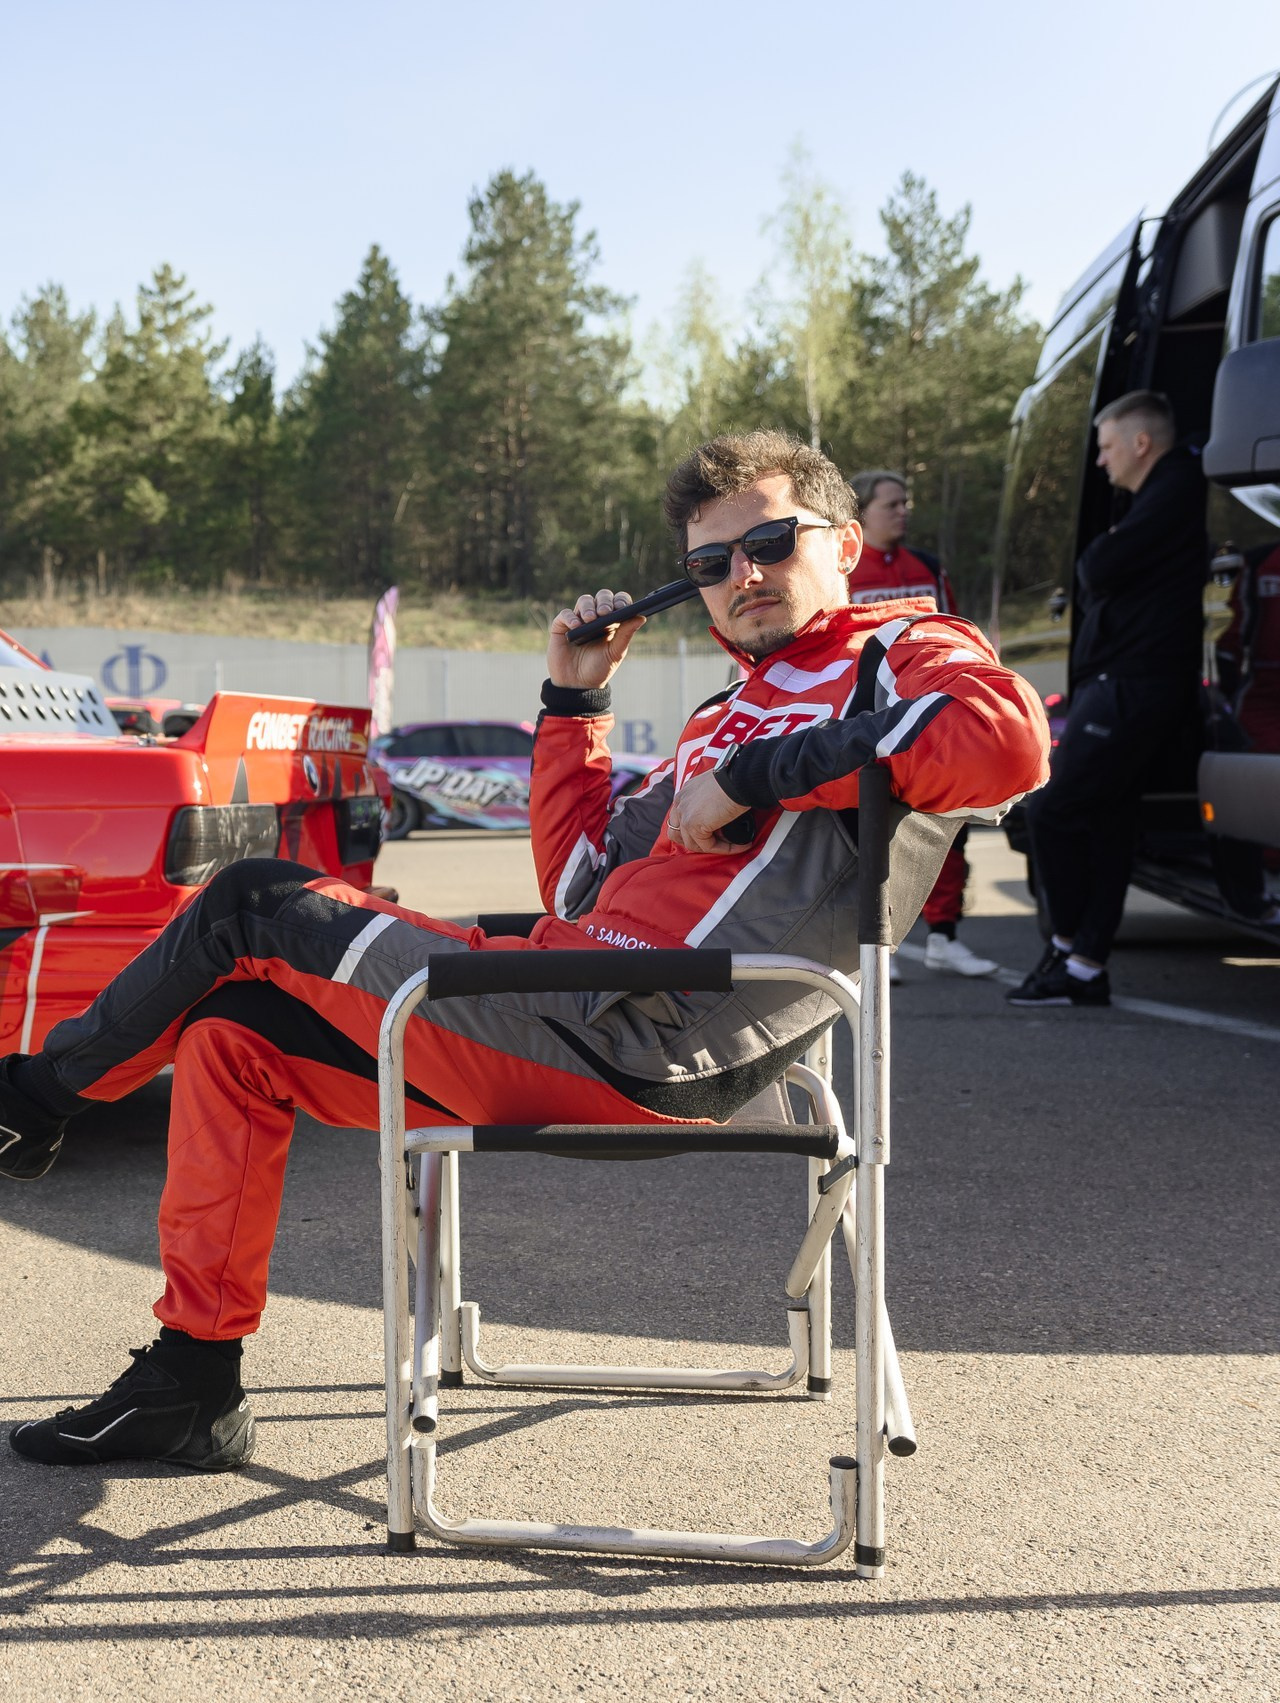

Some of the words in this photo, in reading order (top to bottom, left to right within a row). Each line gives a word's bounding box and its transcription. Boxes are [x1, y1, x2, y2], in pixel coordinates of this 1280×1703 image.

[246, 712, 310, 751] FONBET
[307, 716, 354, 751] RACING
[596, 927, 658, 950] SAMOS
